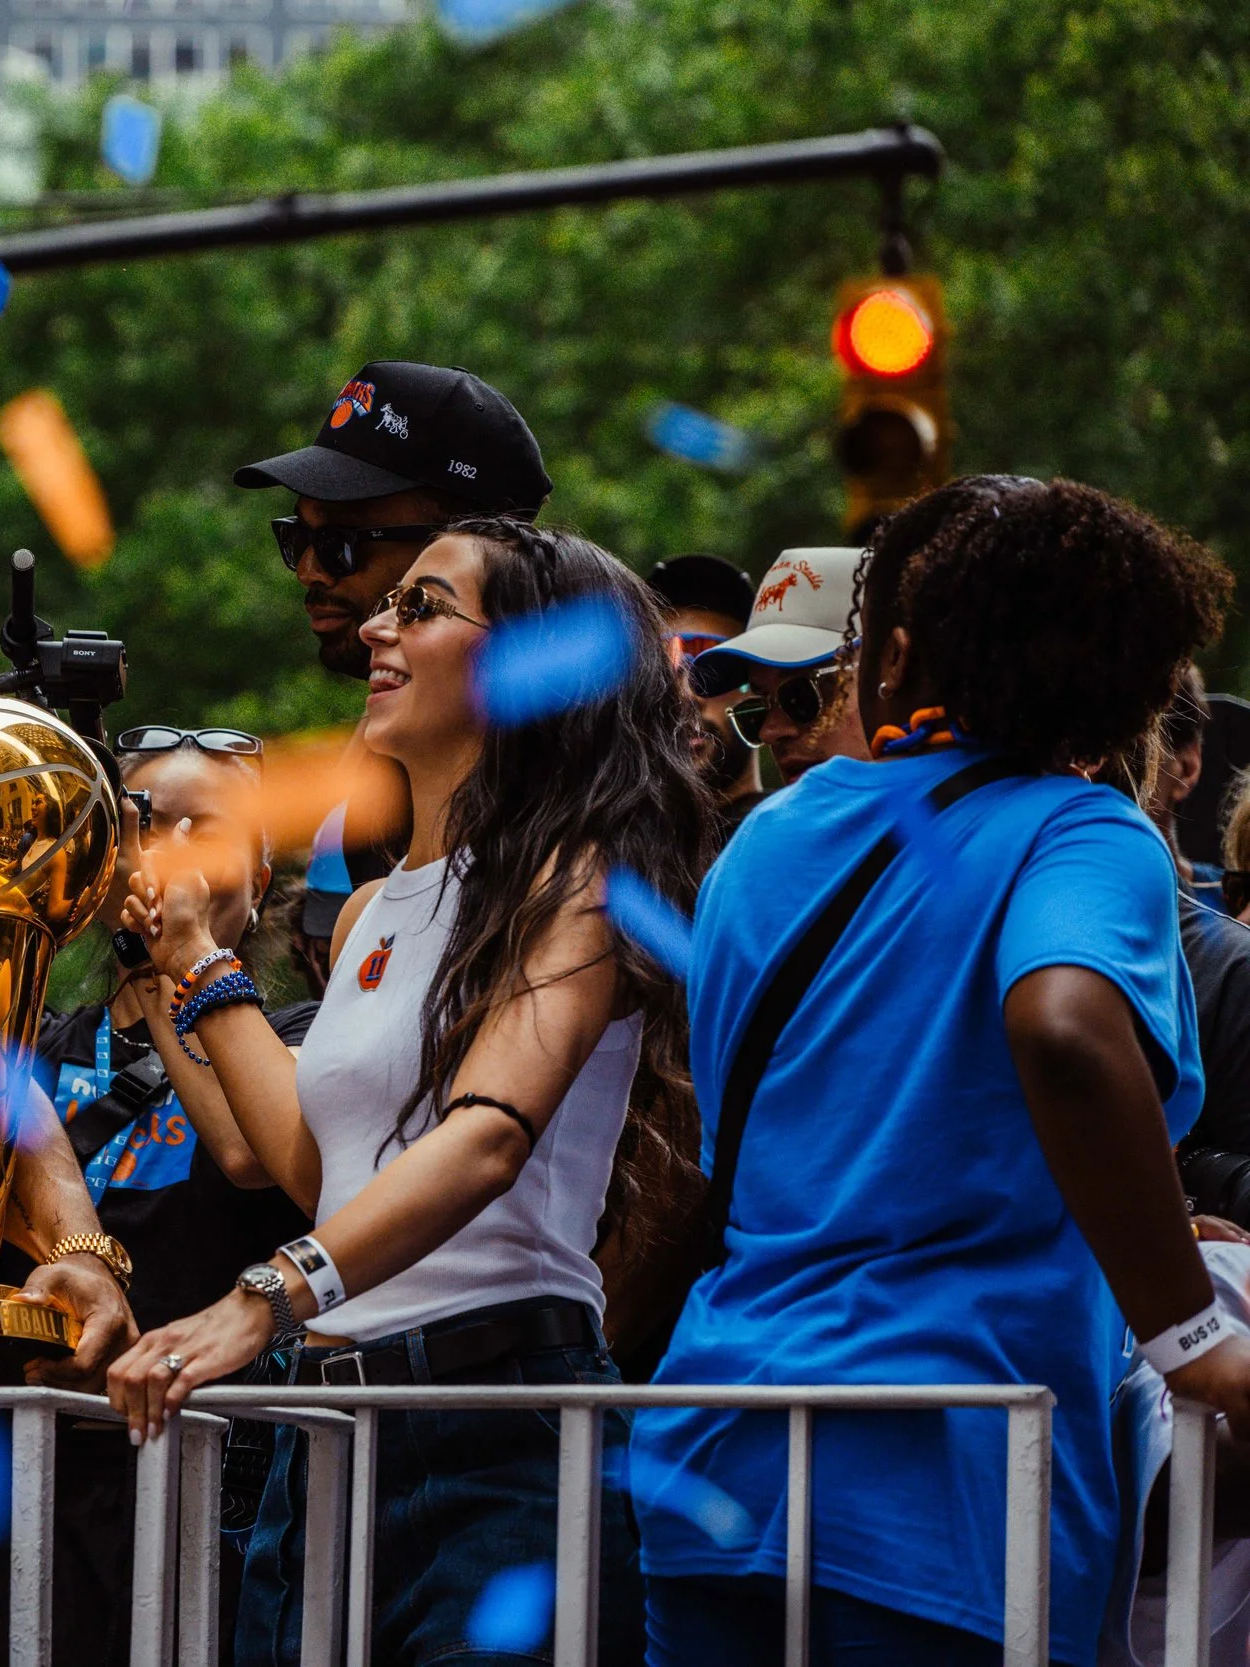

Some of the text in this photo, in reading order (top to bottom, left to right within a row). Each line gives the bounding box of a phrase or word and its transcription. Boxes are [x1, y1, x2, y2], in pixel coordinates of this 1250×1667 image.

[447, 459, 478, 479] 1982
[365, 954, 386, 982] 11
[1178, 1317, 1220, 1351] BUS 13
